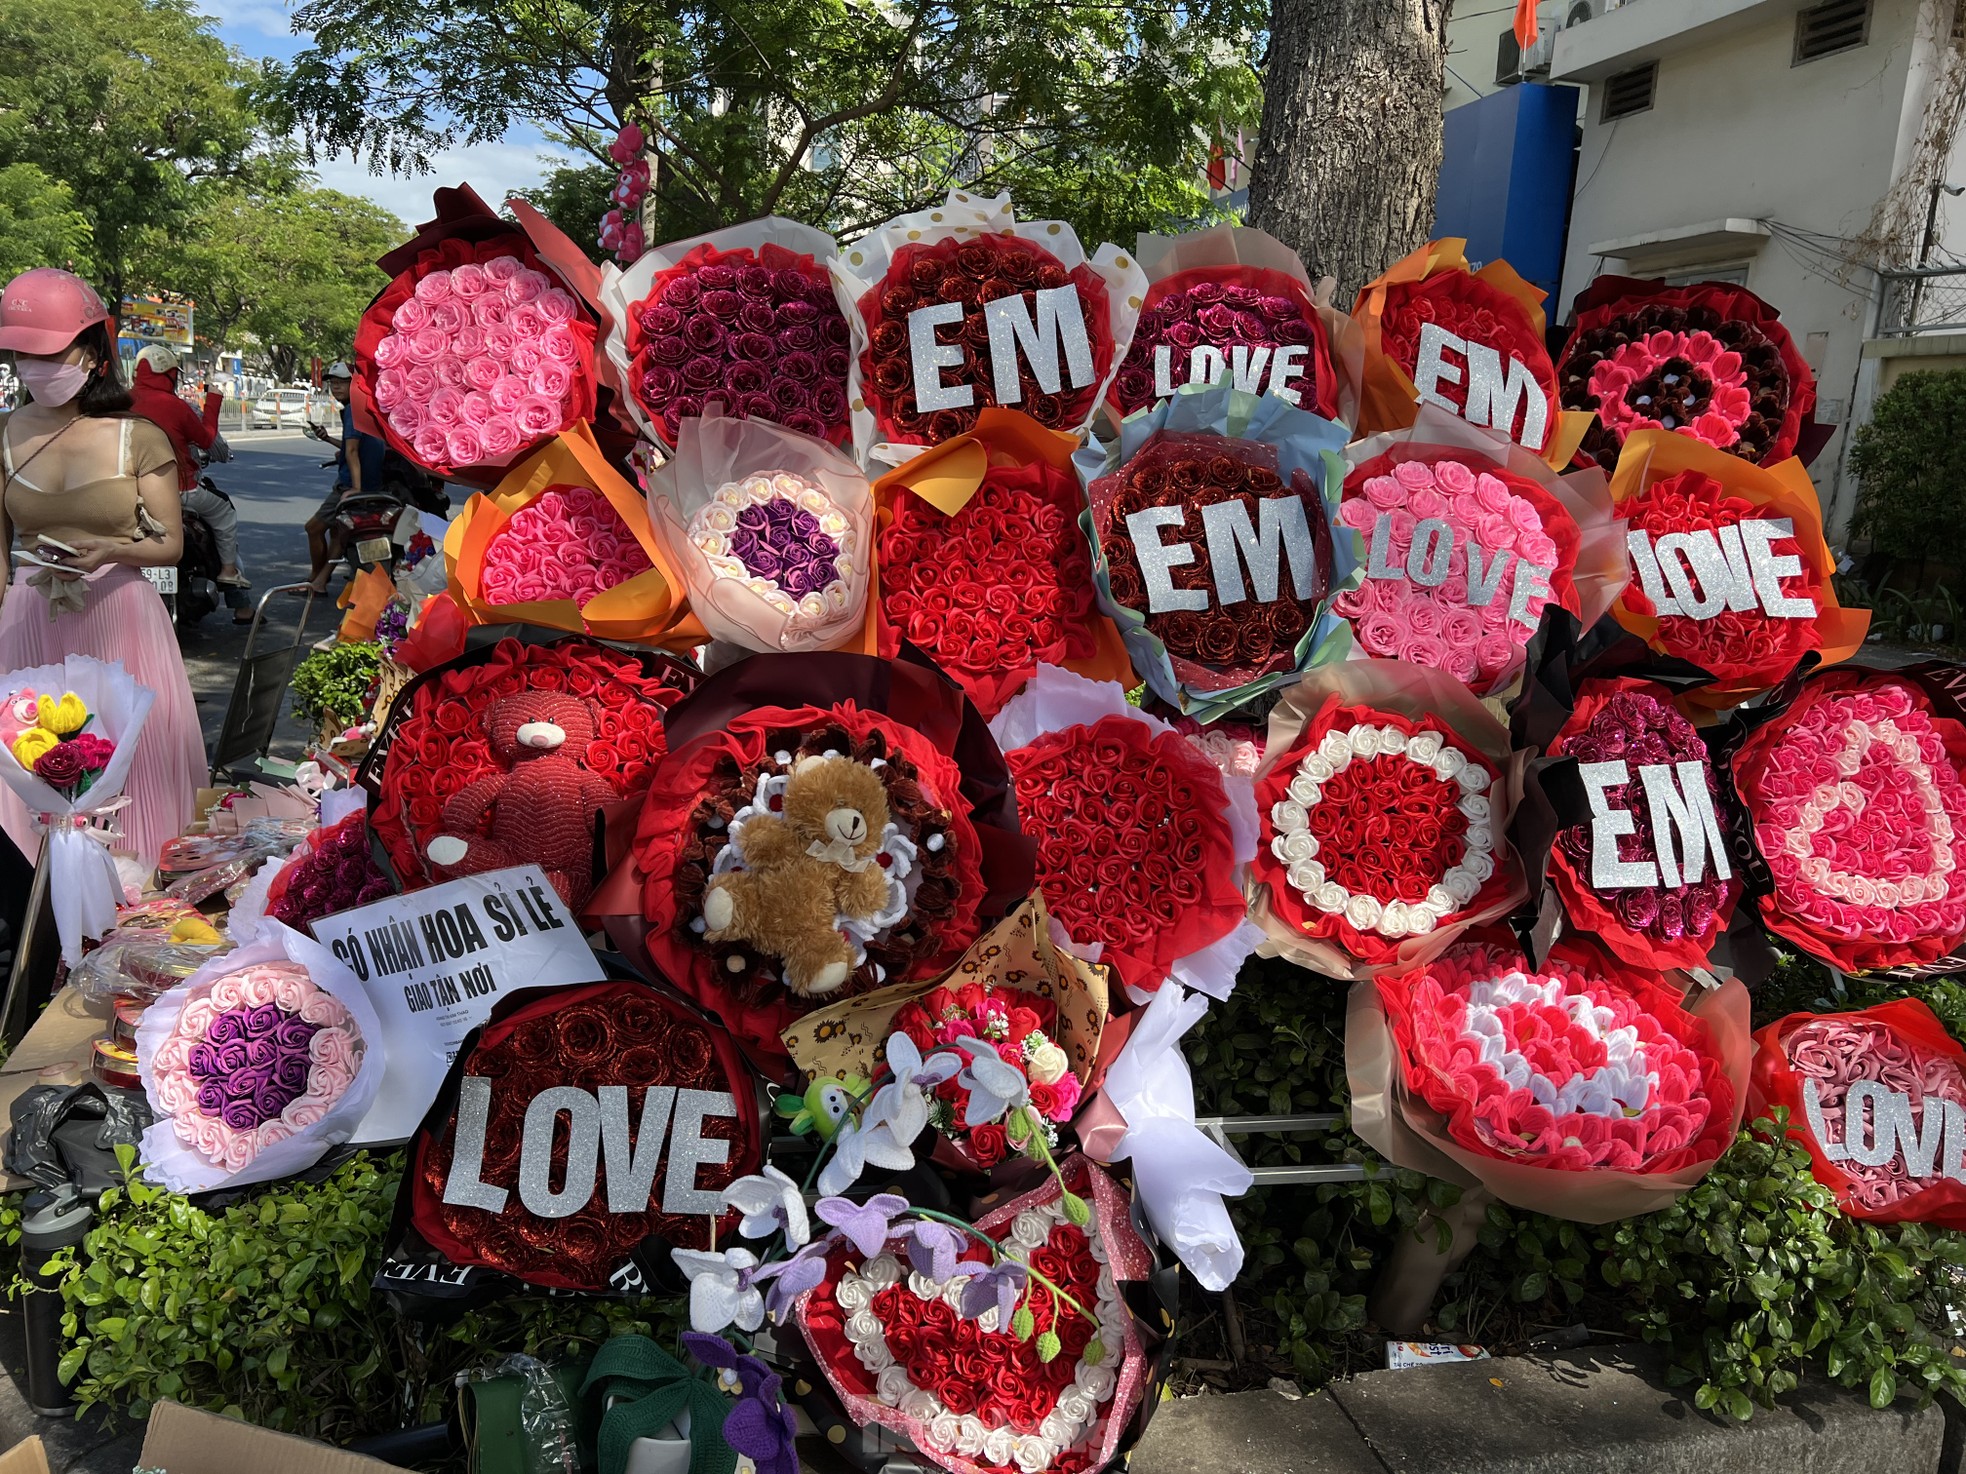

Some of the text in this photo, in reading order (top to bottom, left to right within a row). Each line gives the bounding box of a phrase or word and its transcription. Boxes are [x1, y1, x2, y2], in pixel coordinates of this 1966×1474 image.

[907, 283, 1096, 413] EM
[1154, 344, 1308, 405] LOVE
[1414, 322, 1548, 450] EM
[1126, 495, 1315, 613] EM
[1367, 513, 1553, 630] LOVE
[1627, 518, 1818, 621] LOVE
[1577, 759, 1733, 889] EM
[418, 903, 489, 964] HOA
[482, 882, 529, 942] SỈ
[515, 876, 564, 932] LẺ
[403, 962, 498, 1013] GIAO TẬN NƠI
[443, 1075, 737, 1218] LOVE
